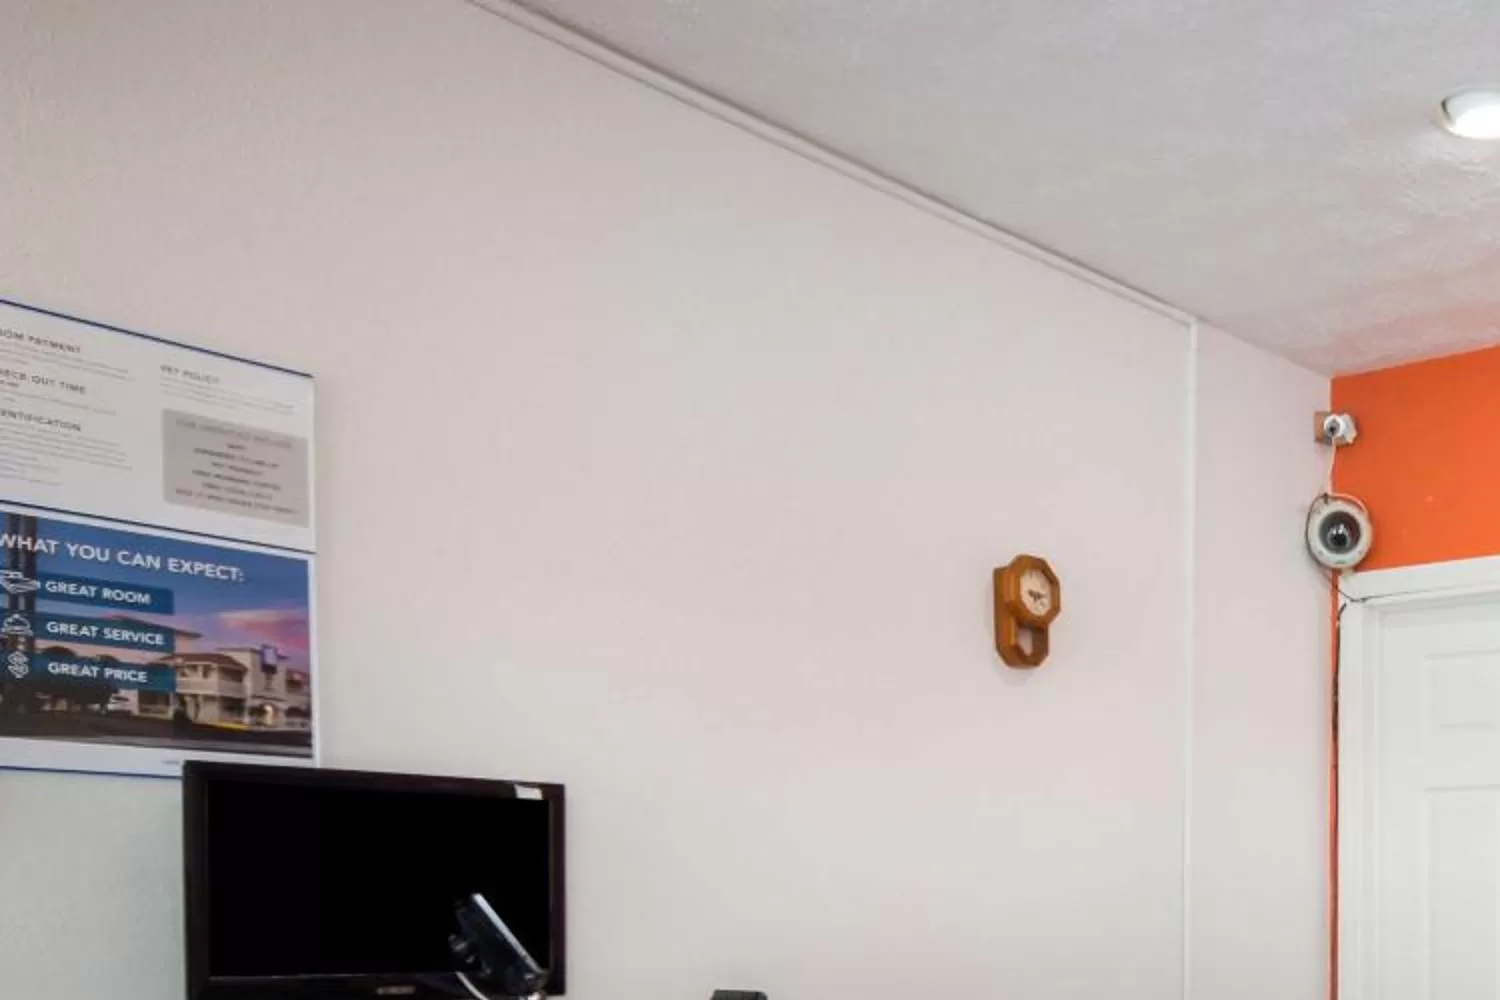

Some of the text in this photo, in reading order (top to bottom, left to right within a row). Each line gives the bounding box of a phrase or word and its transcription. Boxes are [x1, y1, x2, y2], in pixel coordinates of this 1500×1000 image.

[59, 380, 86, 395] TIME
[0, 532, 245, 582] WHAT YOU CAN EXPECT:
[45, 580, 151, 605] GREAT ROOM
[46, 620, 165, 645] GREAT SERVICE
[47, 661, 149, 683] GREAT PRICE
